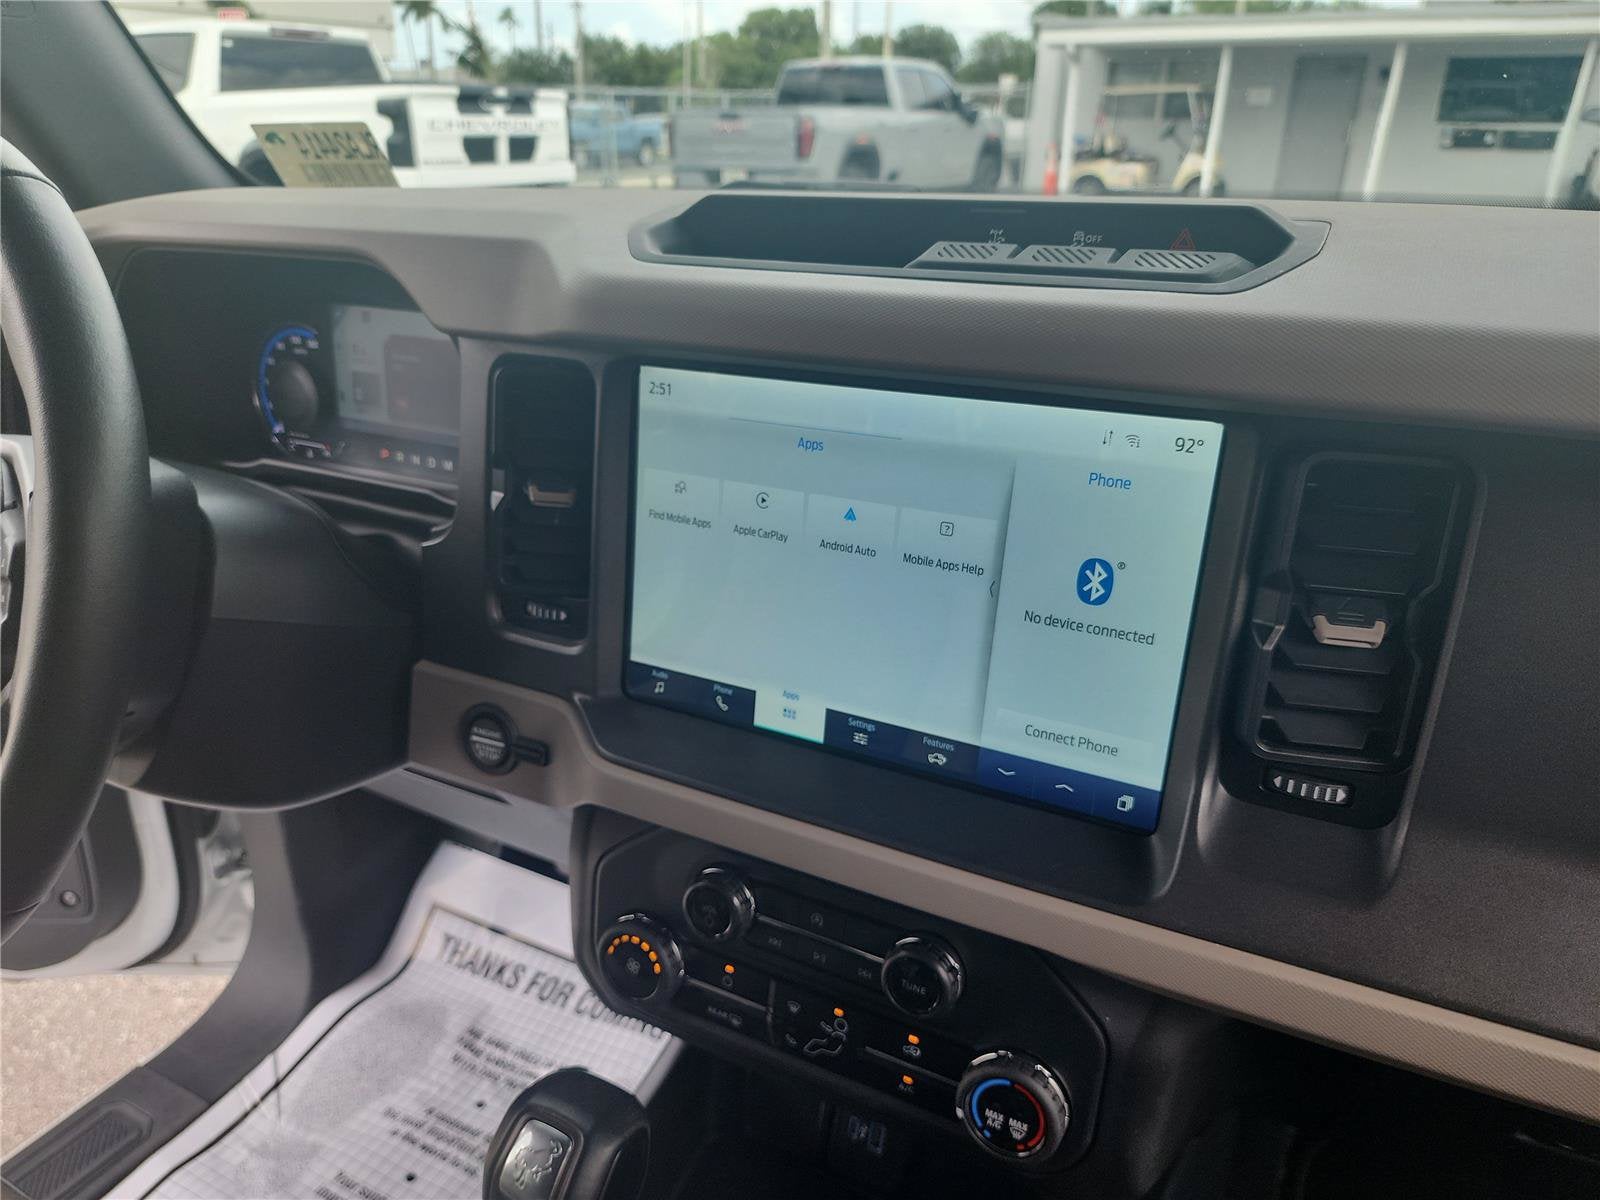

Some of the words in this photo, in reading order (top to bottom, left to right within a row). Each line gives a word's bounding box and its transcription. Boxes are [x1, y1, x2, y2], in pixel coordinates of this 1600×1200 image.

[1085, 234, 1103, 244] OFF
[649, 381, 672, 396] 2:51
[797, 437, 824, 452] Apps
[1174, 437, 1204, 453] 92°
[1088, 472, 1132, 490] Phone
[648, 508, 665, 520] Find
[666, 512, 691, 526] Mobile
[692, 517, 712, 529] Apps
[733, 524, 757, 538] Apple
[757, 528, 789, 543] CarPlay
[819, 538, 854, 554] Android
[855, 545, 877, 558] Auto
[902, 552, 934, 568] Mobile
[935, 558, 960, 573] Apps
[961, 563, 985, 577] Help
[1024, 609, 1042, 624] No
[1043, 614, 1084, 633] device
[1086, 623, 1156, 646] connected
[651, 669, 669, 680] Audio
[713, 684, 734, 696] Phone
[782, 690, 801, 701] Apps
[847, 717, 876, 732] Settings
[922, 736, 955, 752] Features
[1024, 724, 1076, 746] Connect
[1078, 736, 1119, 756] Phone
[441, 931, 526, 989] THANKS
[523, 970, 576, 1009] FOR
[901, 978, 928, 995] TUNE
[985, 1107, 1004, 1121] MAX
[1008, 1117, 1028, 1131] MAX
